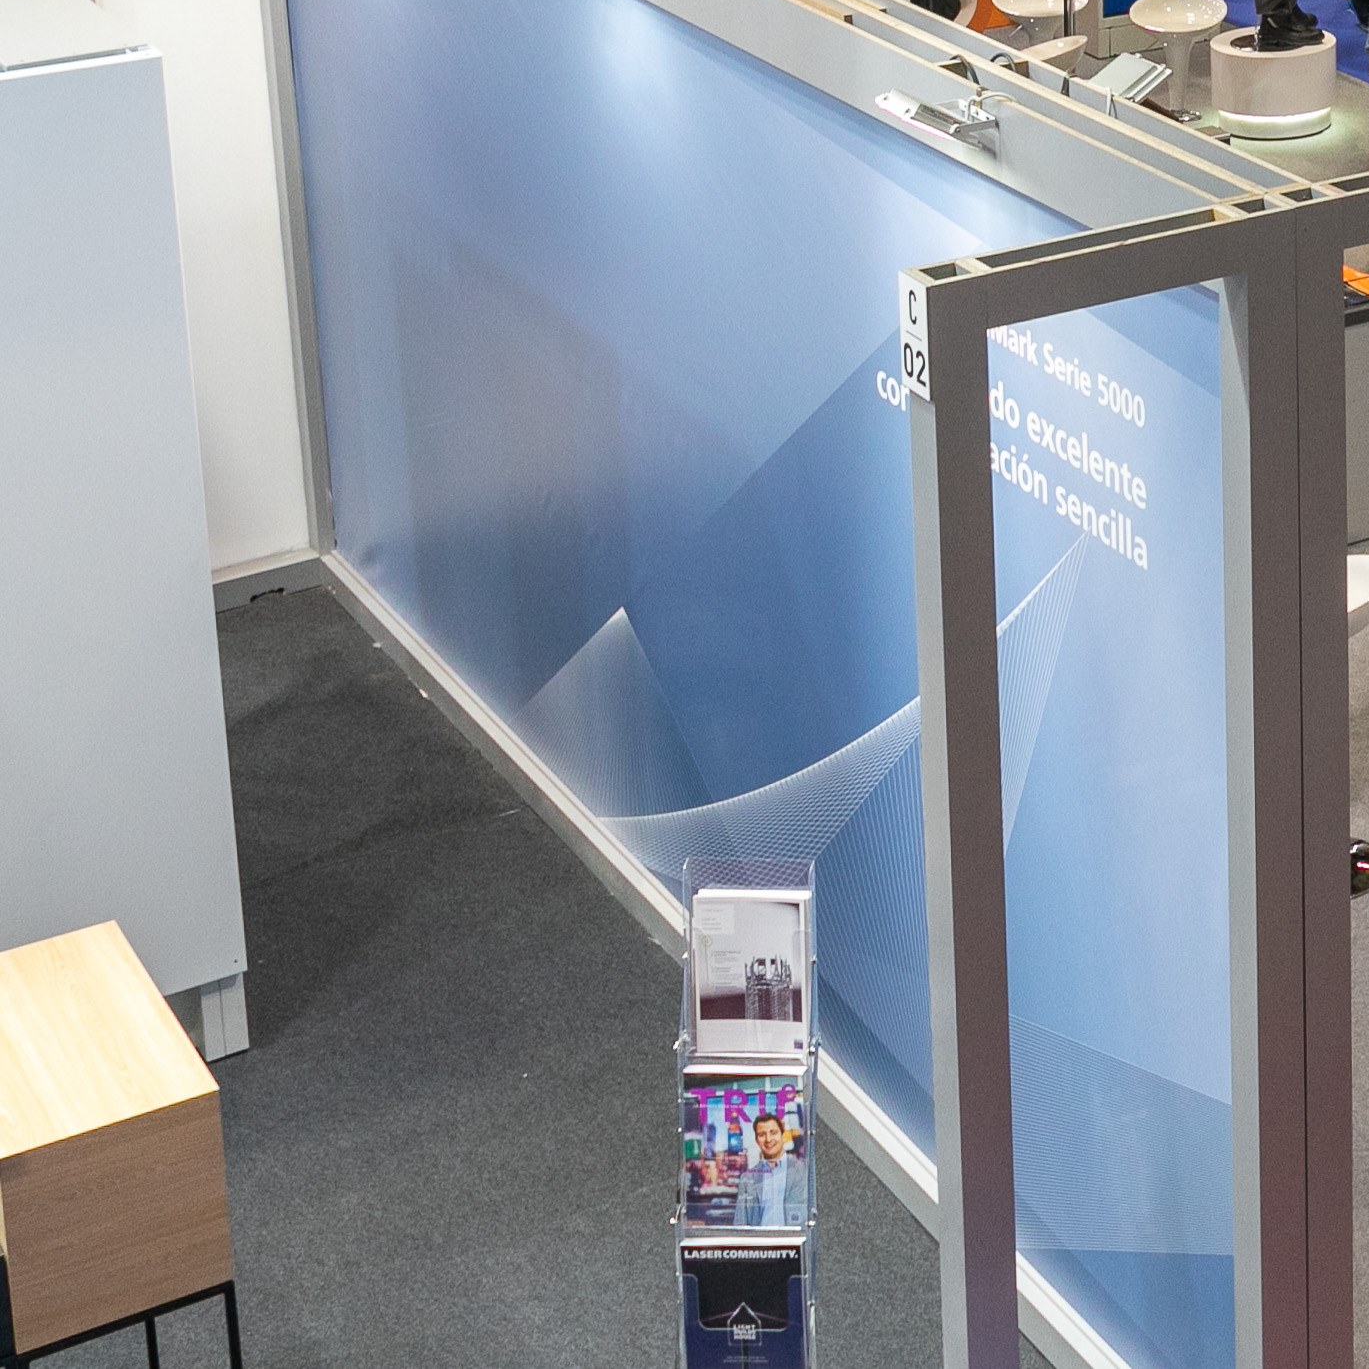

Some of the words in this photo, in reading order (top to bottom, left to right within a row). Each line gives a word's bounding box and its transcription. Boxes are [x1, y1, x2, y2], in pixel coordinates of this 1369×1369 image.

[908, 289, 917, 325] C
[903, 342, 927, 388] 02
[1043, 342, 1092, 397] Serie
[1097, 372, 1146, 429] 5000
[1026, 410, 1148, 510] excelente
[1055, 486, 1149, 571] sencilla
